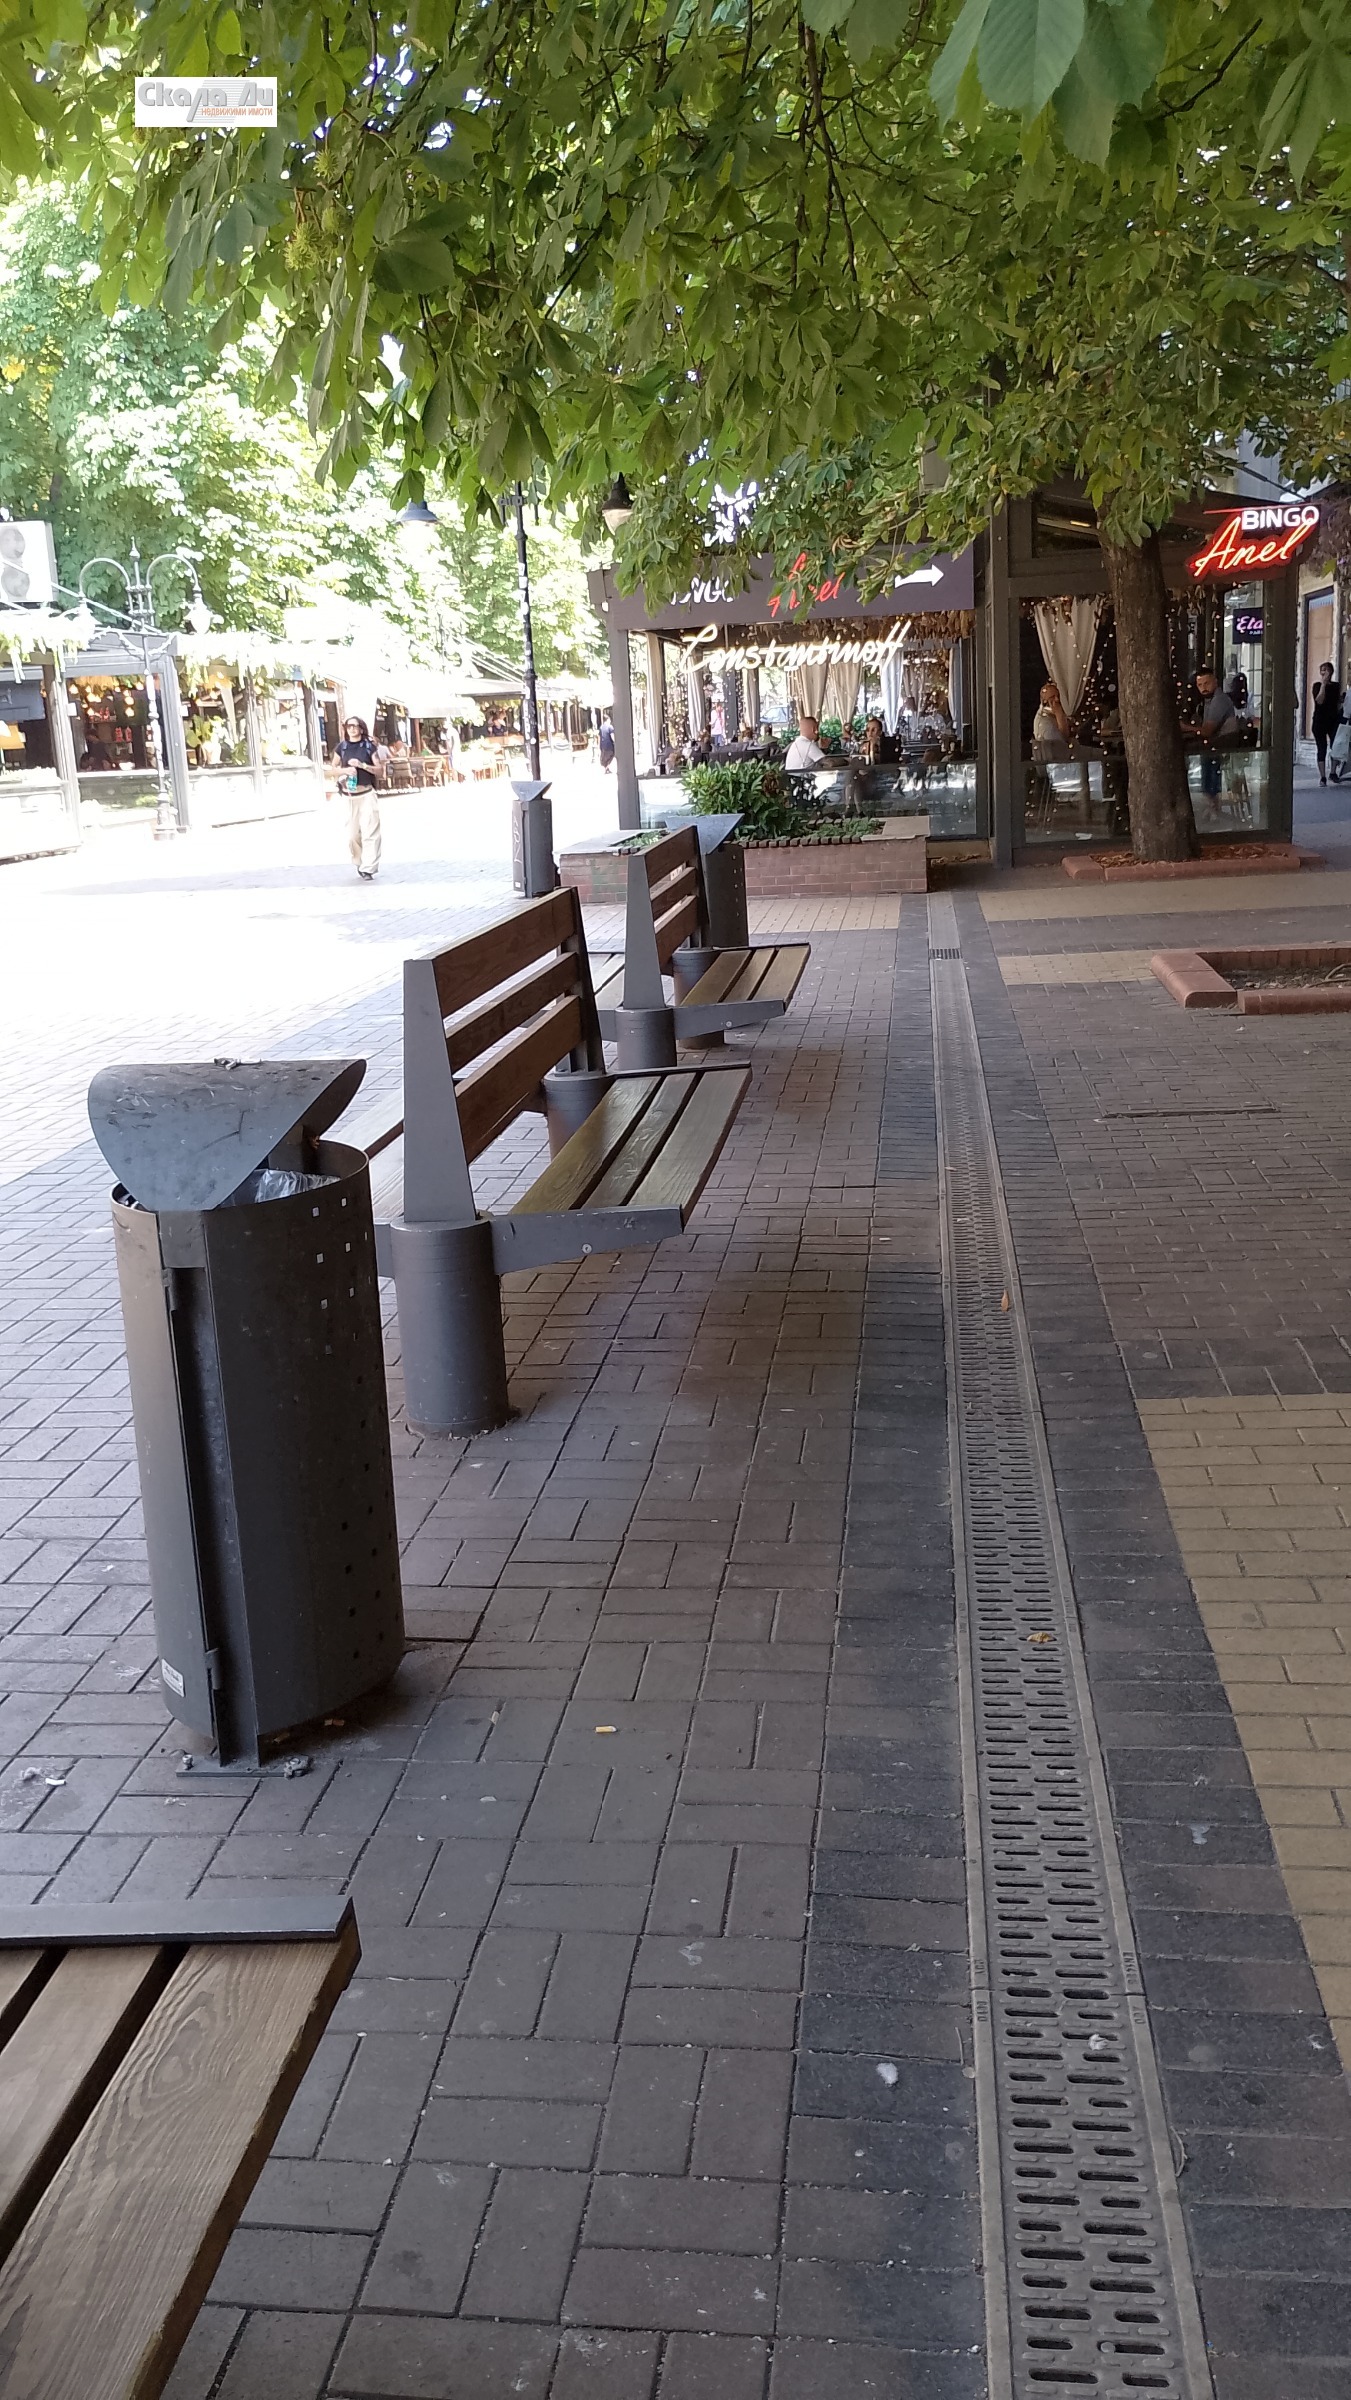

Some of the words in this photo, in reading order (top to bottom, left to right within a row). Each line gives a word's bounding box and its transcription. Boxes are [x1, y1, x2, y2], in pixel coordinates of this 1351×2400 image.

[1241, 505, 1320, 531] BINGO
[1193, 516, 1313, 577] Anel
[679, 619, 911, 674] Constantinoff
